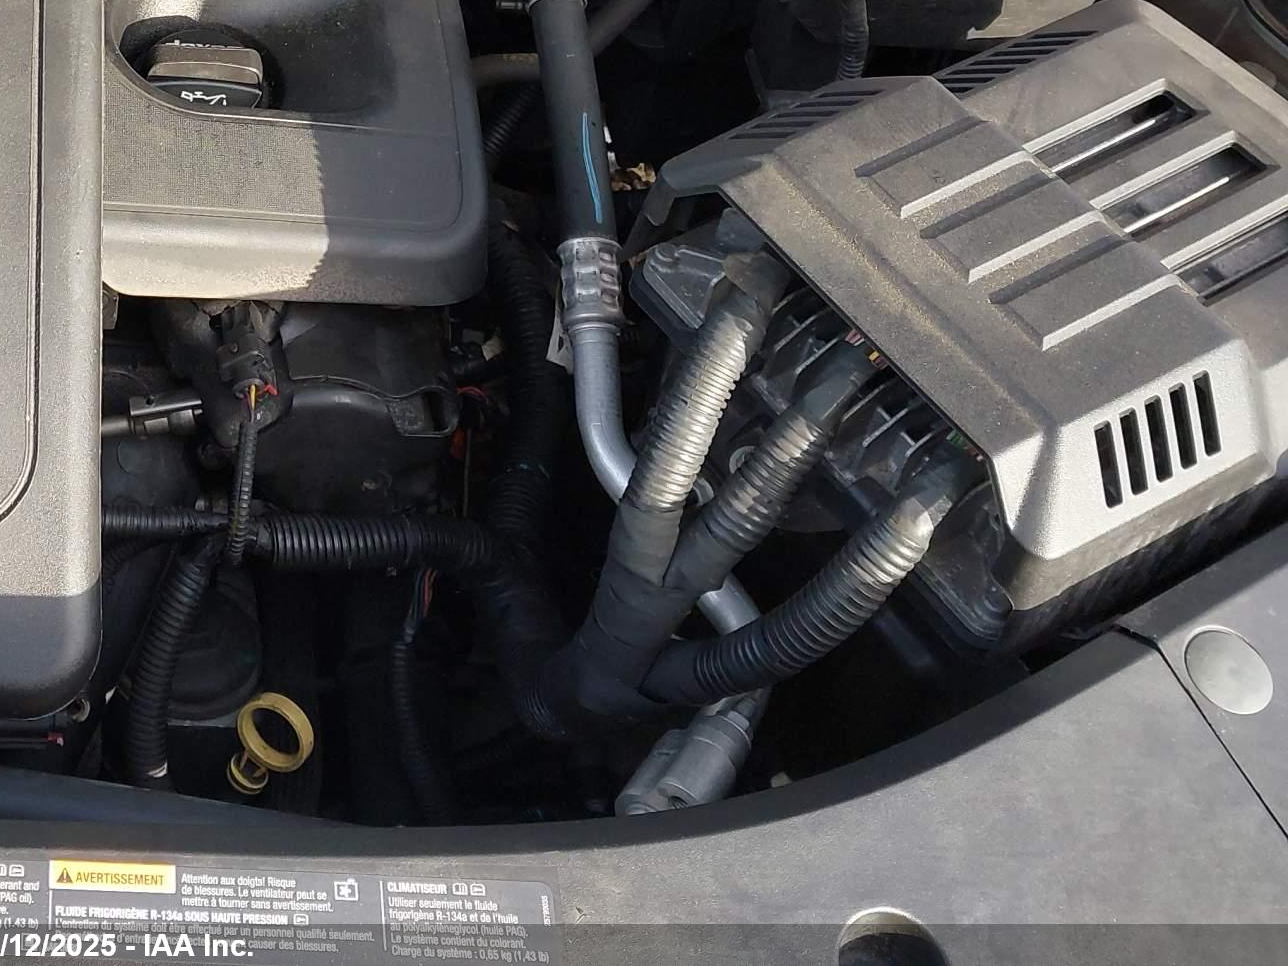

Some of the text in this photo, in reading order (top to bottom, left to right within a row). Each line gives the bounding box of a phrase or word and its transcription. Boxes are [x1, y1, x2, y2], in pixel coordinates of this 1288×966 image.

[23, 881, 40, 891] and
[76, 871, 164, 886] AVERTISSEMENT
[181, 874, 218, 884] Attention
[220, 876, 235, 886] aux
[268, 877, 296, 889] Risque
[182, 885, 327, 901] de blessures. Le ventilateur peut se
[388, 882, 448, 894] CLIMATISEUR
[182, 896, 209, 906] mettre
[218, 898, 248, 909] tourner
[251, 900, 270, 909] sans
[272, 902, 334, 912] avertissement.
[388, 896, 498, 912] Utiliser seulement le fluide
[55, 906, 288, 925] FLUIDE FRIGORIGÈNE R-134a SOUS HAUTE PRESSION
[390, 909, 518, 924] frigorigène R-134a et de l'huile
[56, 918, 100, 930] L'entretien
[101, 920, 112, 930] du
[114, 921, 150, 934] système
[151, 922, 166, 932] doit
[224, 928, 237, 938] par
[240, 928, 251, 936] un
[252, 928, 294, 939] personnel
[328, 930, 374, 942] seulement.
[390, 924, 401, 932] au
[480, 926, 504, 937] (huile
[248, 940, 276, 950] causer
[278, 940, 294, 950] des
[391, 934, 402, 944] Le
[404, 935, 439, 946] système
[441, 936, 475, 946] contient
[478, 937, 488, 947] du
[392, 946, 422, 958] Charge
[424, 947, 436, 957] du
[438, 948, 472, 960] système
[501, 951, 512, 962] kg
